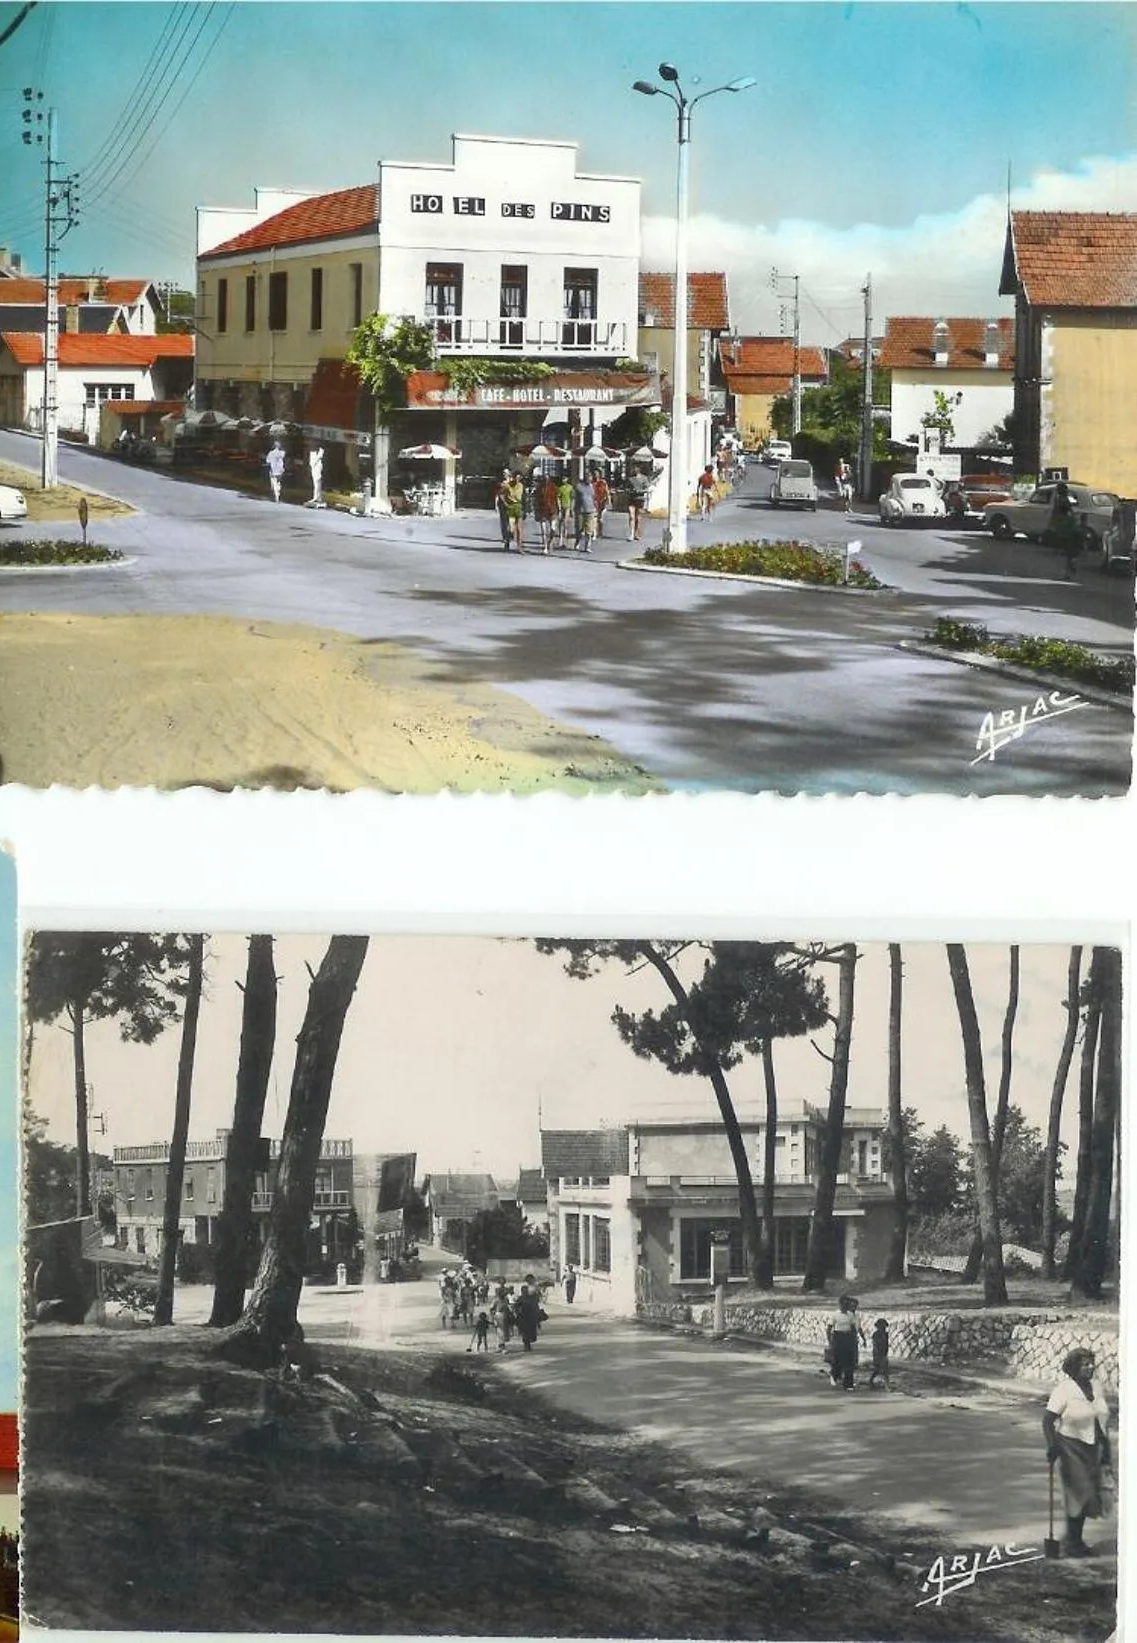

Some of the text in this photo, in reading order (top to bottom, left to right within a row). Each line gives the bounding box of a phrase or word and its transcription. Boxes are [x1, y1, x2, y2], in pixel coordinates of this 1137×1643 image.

[502, 204, 535, 217] DES
[551, 204, 610, 221] PINS
[554, 388, 614, 401] RESTAURANT
